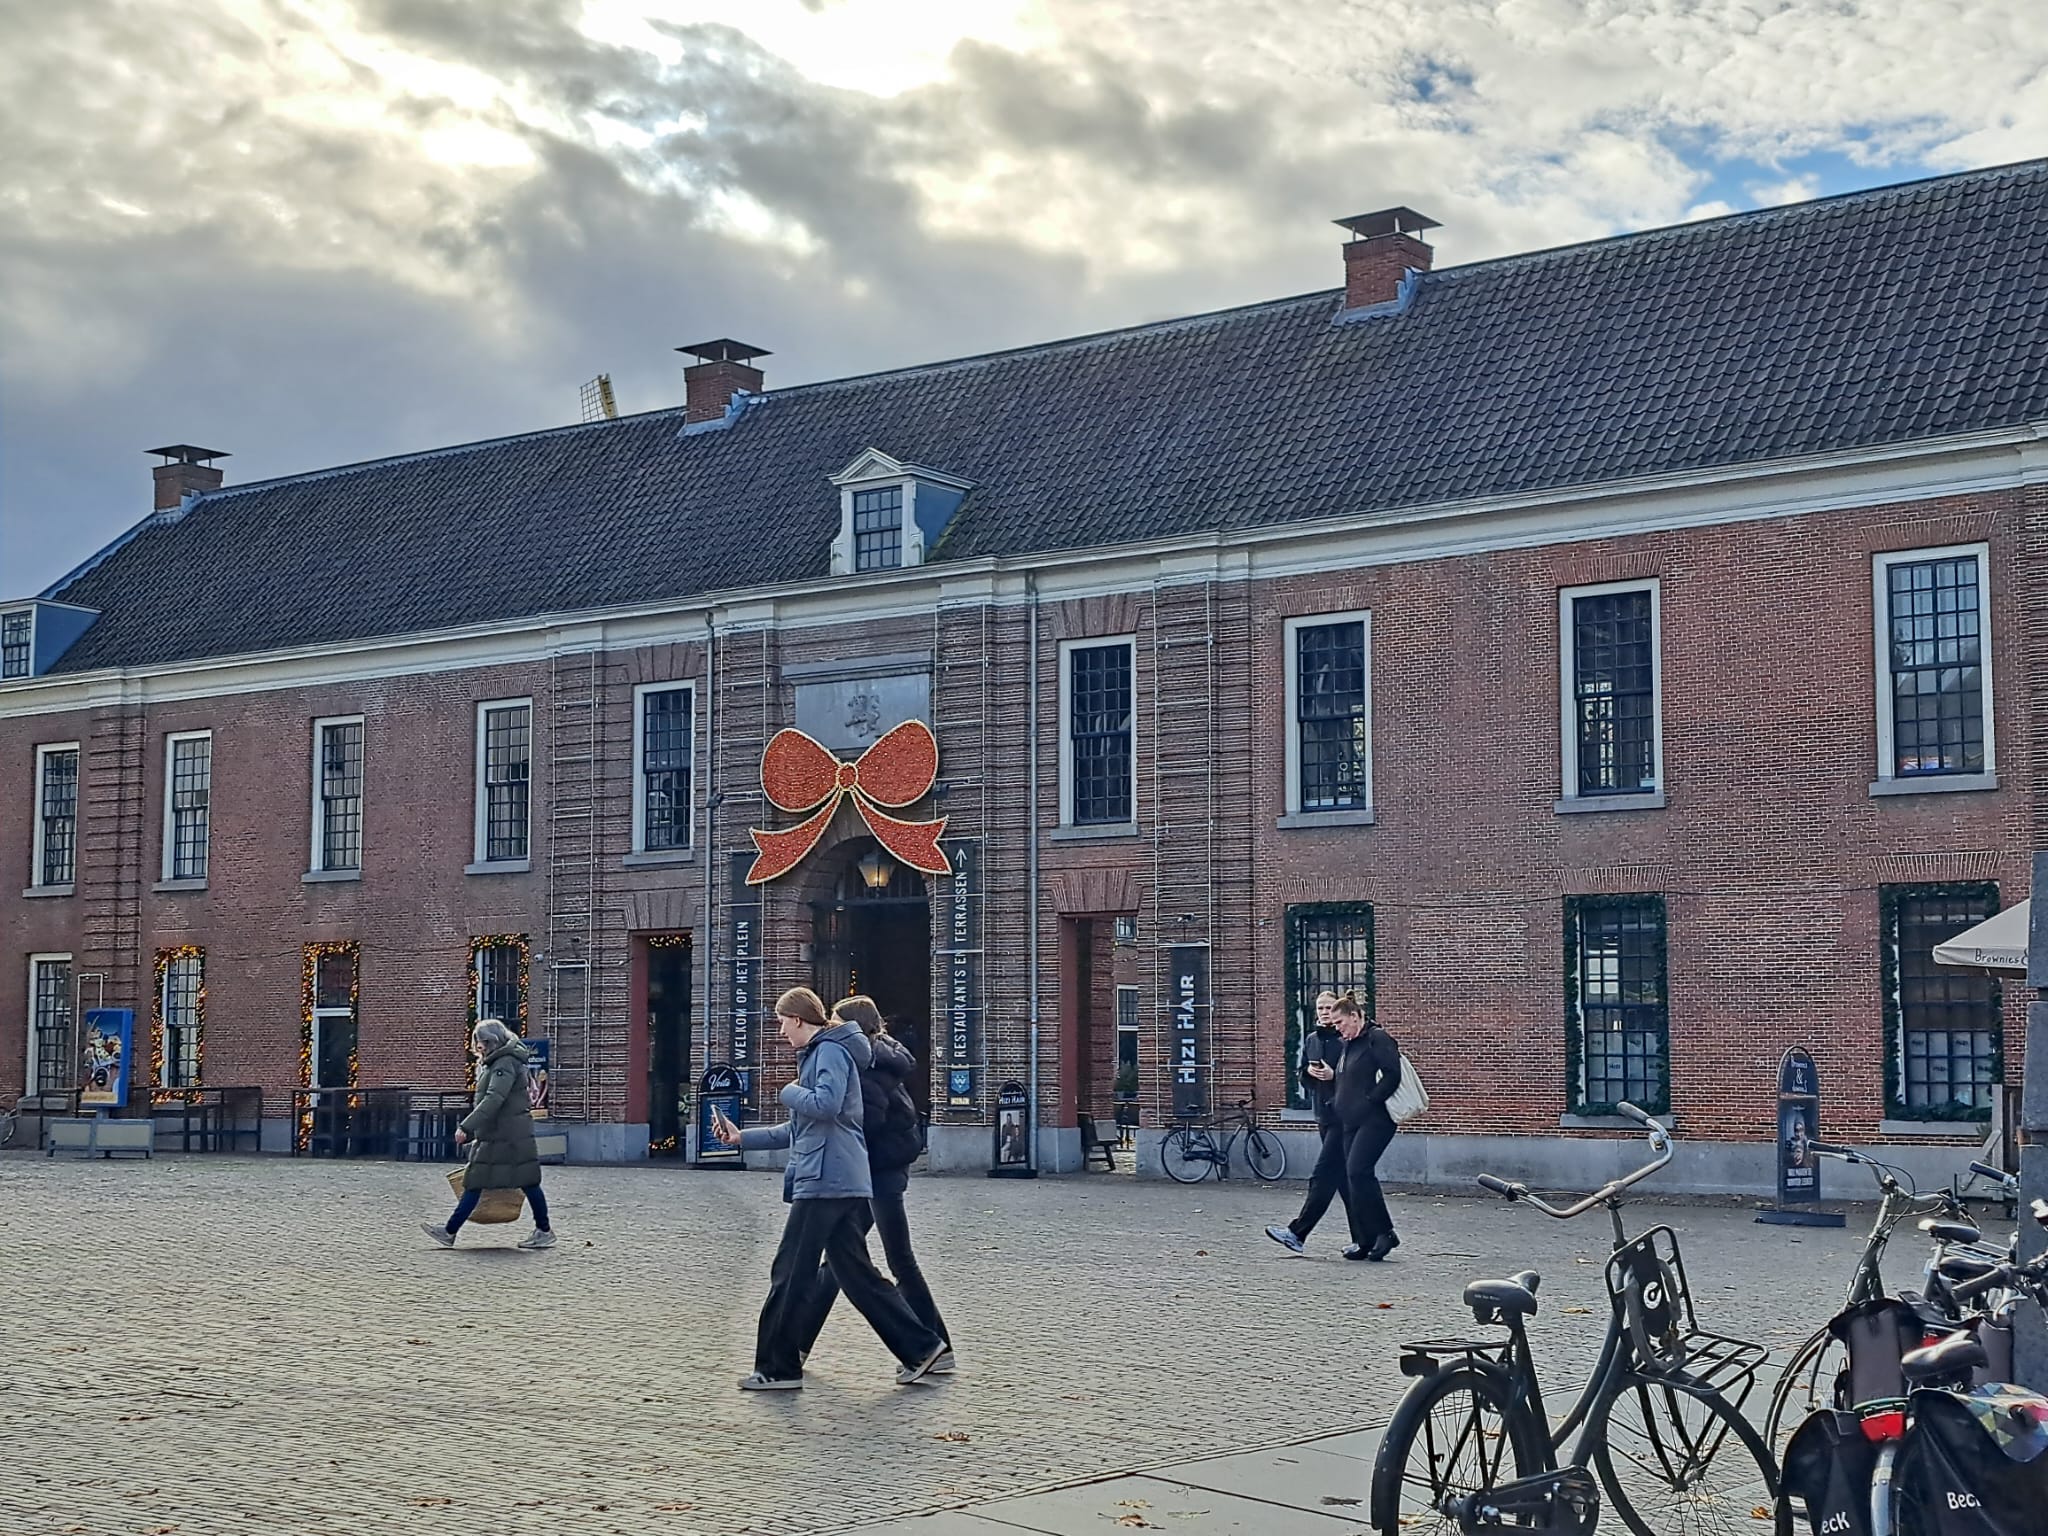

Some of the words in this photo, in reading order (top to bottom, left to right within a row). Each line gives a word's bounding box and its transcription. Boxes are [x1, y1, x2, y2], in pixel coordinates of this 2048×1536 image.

[954, 871, 967, 943] TERRASSEN
[736, 921, 749, 955] PLEIN
[736, 961, 748, 983] HET
[736, 988, 748, 1003] OP
[954, 969, 967, 1058] RESTAURANTS
[1177, 975, 1195, 1029] HAIR
[734, 1007, 748, 1060] WELKOM
[1178, 1038, 1196, 1083] HIZI
[1946, 1491, 1982, 1510] Bec
